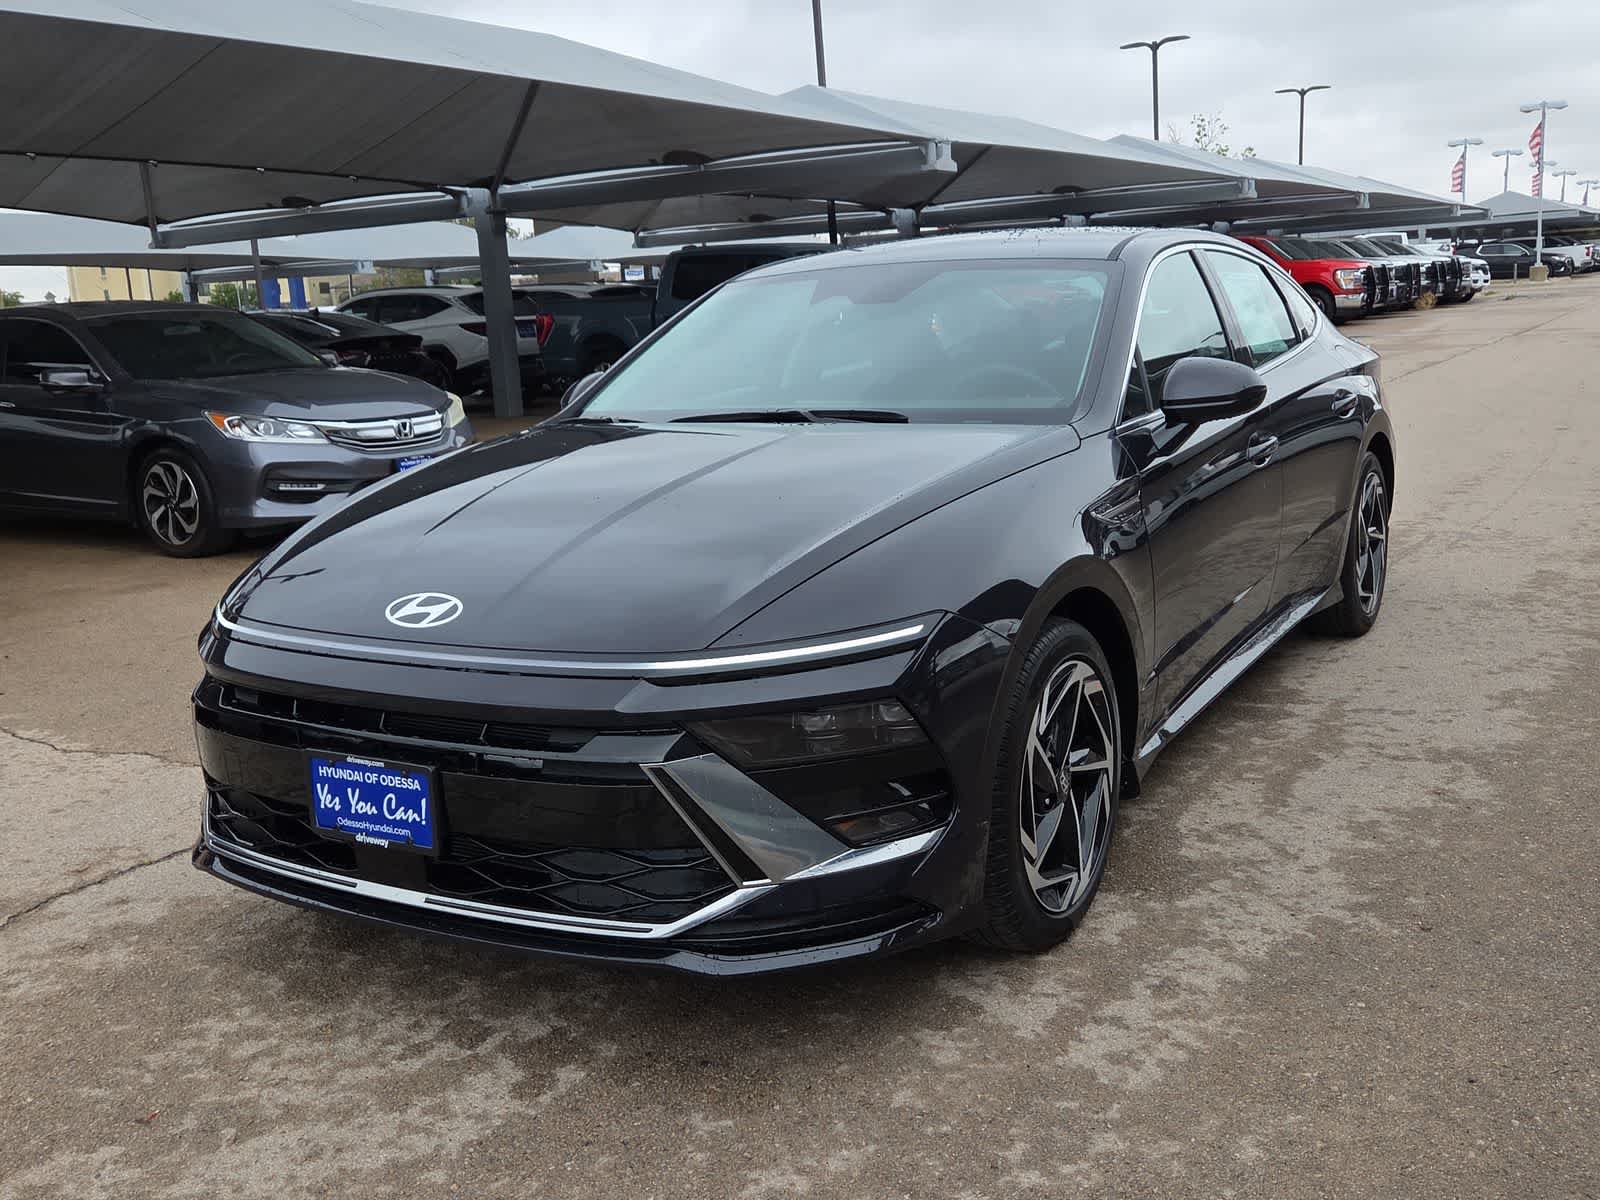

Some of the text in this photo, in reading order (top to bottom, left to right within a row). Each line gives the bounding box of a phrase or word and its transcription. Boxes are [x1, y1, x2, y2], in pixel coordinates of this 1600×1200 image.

[346, 755, 385, 768] driveway.com
[318, 766, 421, 791] HYUNDAI OF ODESSA
[316, 783, 427, 825] Yes You Can!
[337, 816, 411, 838] OdessaHyundai.com
[355, 832, 389, 848] driveway
